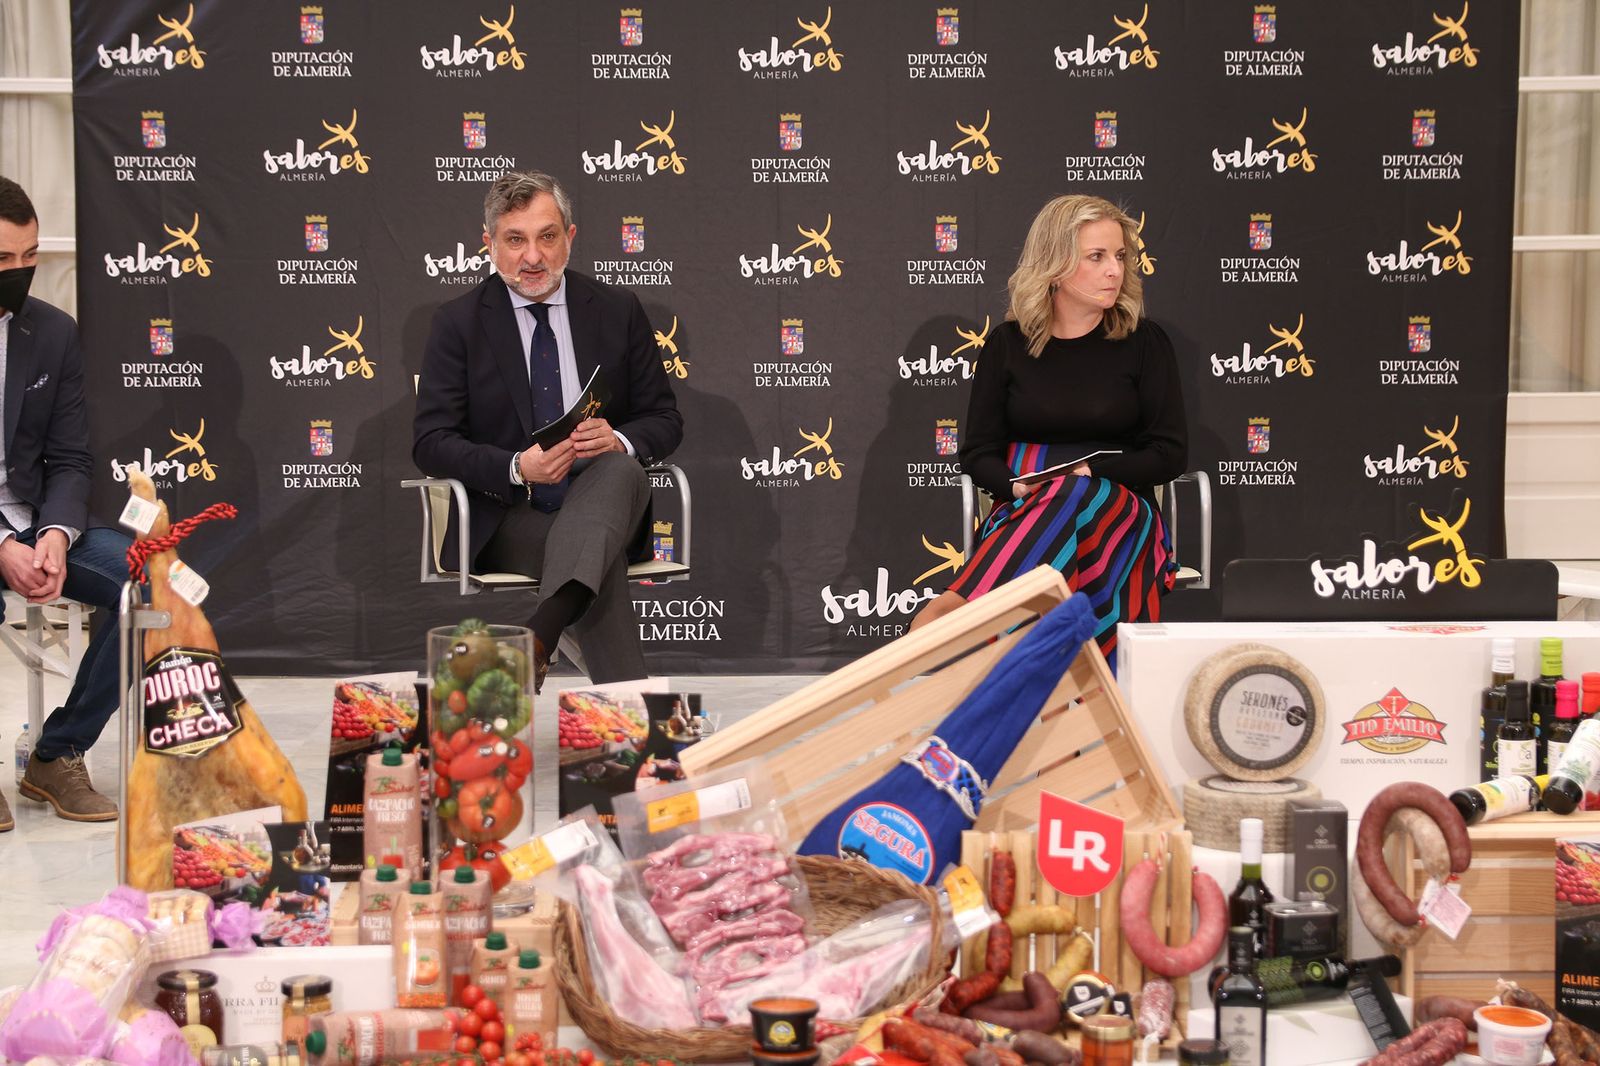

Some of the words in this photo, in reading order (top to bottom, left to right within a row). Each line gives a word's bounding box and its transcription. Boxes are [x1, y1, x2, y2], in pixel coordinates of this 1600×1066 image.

[97, 33, 207, 70] sabores
[272, 50, 352, 63] DIPUTACIÓN
[420, 35, 527, 71] sabores
[738, 36, 844, 72] sabores
[1054, 35, 1160, 70] sabores
[1225, 49, 1304, 61] DIPUTACIÓN
[1372, 32, 1479, 68] sabores
[592, 52, 671, 65] DIPUTACIÓN
[908, 51, 987, 64] DIPUTACIÓN
[114, 68, 160, 76] ALMERÍA
[274, 66, 291, 76] DE
[294, 63, 351, 76] ALMERÍA
[436, 69, 481, 77] ALMERÍA
[593, 68, 610, 78] DE
[613, 66, 670, 78] ALMERÍA
[754, 70, 798, 79] ALMERÍA
[910, 68, 926, 78] DE
[929, 65, 985, 78] ALMERÍA
[1070, 68, 1114, 77] ALMERÍA
[1226, 65, 1242, 75] DE
[1246, 61, 1302, 75] ALMERÍA
[1388, 67, 1432, 75] ALMERÍA
[114, 154, 196, 167] DIPUTACIÓN
[263, 139, 371, 175] sabores
[435, 155, 515, 168] DIPUTACIÓN
[582, 140, 687, 175] sabores
[897, 140, 1002, 175] sabores
[1066, 154, 1145, 166] DIPUTACIÓN
[1212, 137, 1318, 173] sabores
[1383, 152, 1463, 165] DIPUTACIÓN
[752, 156, 830, 169] DIPUTACIÓN
[116, 170, 134, 181] DE
[137, 168, 195, 181] ALMERÍA
[280, 172, 325, 181] ALMERÍA
[437, 170, 454, 182] DE
[457, 169, 509, 182] ALMERÍ
[598, 173, 642, 182] ALMERÍA
[753, 172, 769, 182] DE
[773, 169, 829, 182] ALMERÍA
[912, 172, 957, 182] ALMERÍA
[1067, 170, 1083, 180] DE
[1087, 166, 1143, 180] ALMERÍA
[1227, 171, 1271, 179] ALMERÍA
[1384, 169, 1400, 179] DE
[1403, 165, 1460, 179] ALMERÍA
[104, 242, 213, 278] sabores
[277, 258, 357, 271] DIPUTACIÓN
[739, 243, 844, 278] sabores
[907, 258, 985, 271] DIPUTACIÓN
[1221, 256, 1300, 269] DIPUTACIÓN
[1367, 240, 1473, 276] sabores
[594, 259, 673, 271] DIPUTACIÓN
[121, 276, 167, 284] ALMERÍA
[279, 274, 296, 284] DE
[300, 271, 356, 284] ALMERÍA
[615, 272, 672, 285] ALMERÍA
[754, 276, 799, 285] ALMERÍA
[909, 274, 925, 284] DE
[928, 271, 984, 284] ALMERÍA
[1222, 272, 1238, 282] DE
[1242, 269, 1298, 282] ALMERÍA
[1382, 274, 1426, 282] ALMERÍA
[122, 361, 202, 374] DIPUTACIÓN
[270, 345, 376, 381] sabores
[754, 360, 832, 373] DIPUTACIÓN
[898, 345, 977, 380] sabor
[1211, 343, 1315, 379] sabores
[1380, 358, 1459, 371] DIPUTACIÓN
[124, 377, 141, 387] DE
[144, 374, 201, 387] ALMERÍA
[286, 378, 331, 387] ALMERÍA
[755, 377, 771, 386] DE
[775, 374, 830, 386] ALMERÍA
[913, 378, 957, 386] ALMERÍA
[1226, 376, 1270, 384] ALMERÍA
[1382, 374, 1398, 384] DE
[1401, 371, 1458, 384] ALMERÍA
[282, 462, 361, 475] DIPUTACIÓN
[741, 446, 845, 482] sabores
[1219, 459, 1297, 472] DIPUTACIÓN
[1364, 444, 1469, 481] sabores
[284, 478, 300, 488] DE
[304, 475, 360, 488] ALMERÍA
[756, 479, 799, 487] ALMERÍA
[909, 476, 925, 487] DE
[1220, 475, 1236, 484] DE
[1239, 472, 1295, 485] ALMERÍA
[1379, 477, 1423, 485] ALMERÍA
[1311, 540, 1486, 598] sabores
[1342, 588, 1407, 600] ALMERÍA
[847, 623, 907, 637] ALMER
[149, 712, 233, 747] CHECA
[1383, 717, 1438, 736] EMILIO
[853, 809, 925, 869] SEGURA
[1048, 819, 1111, 873] LR
